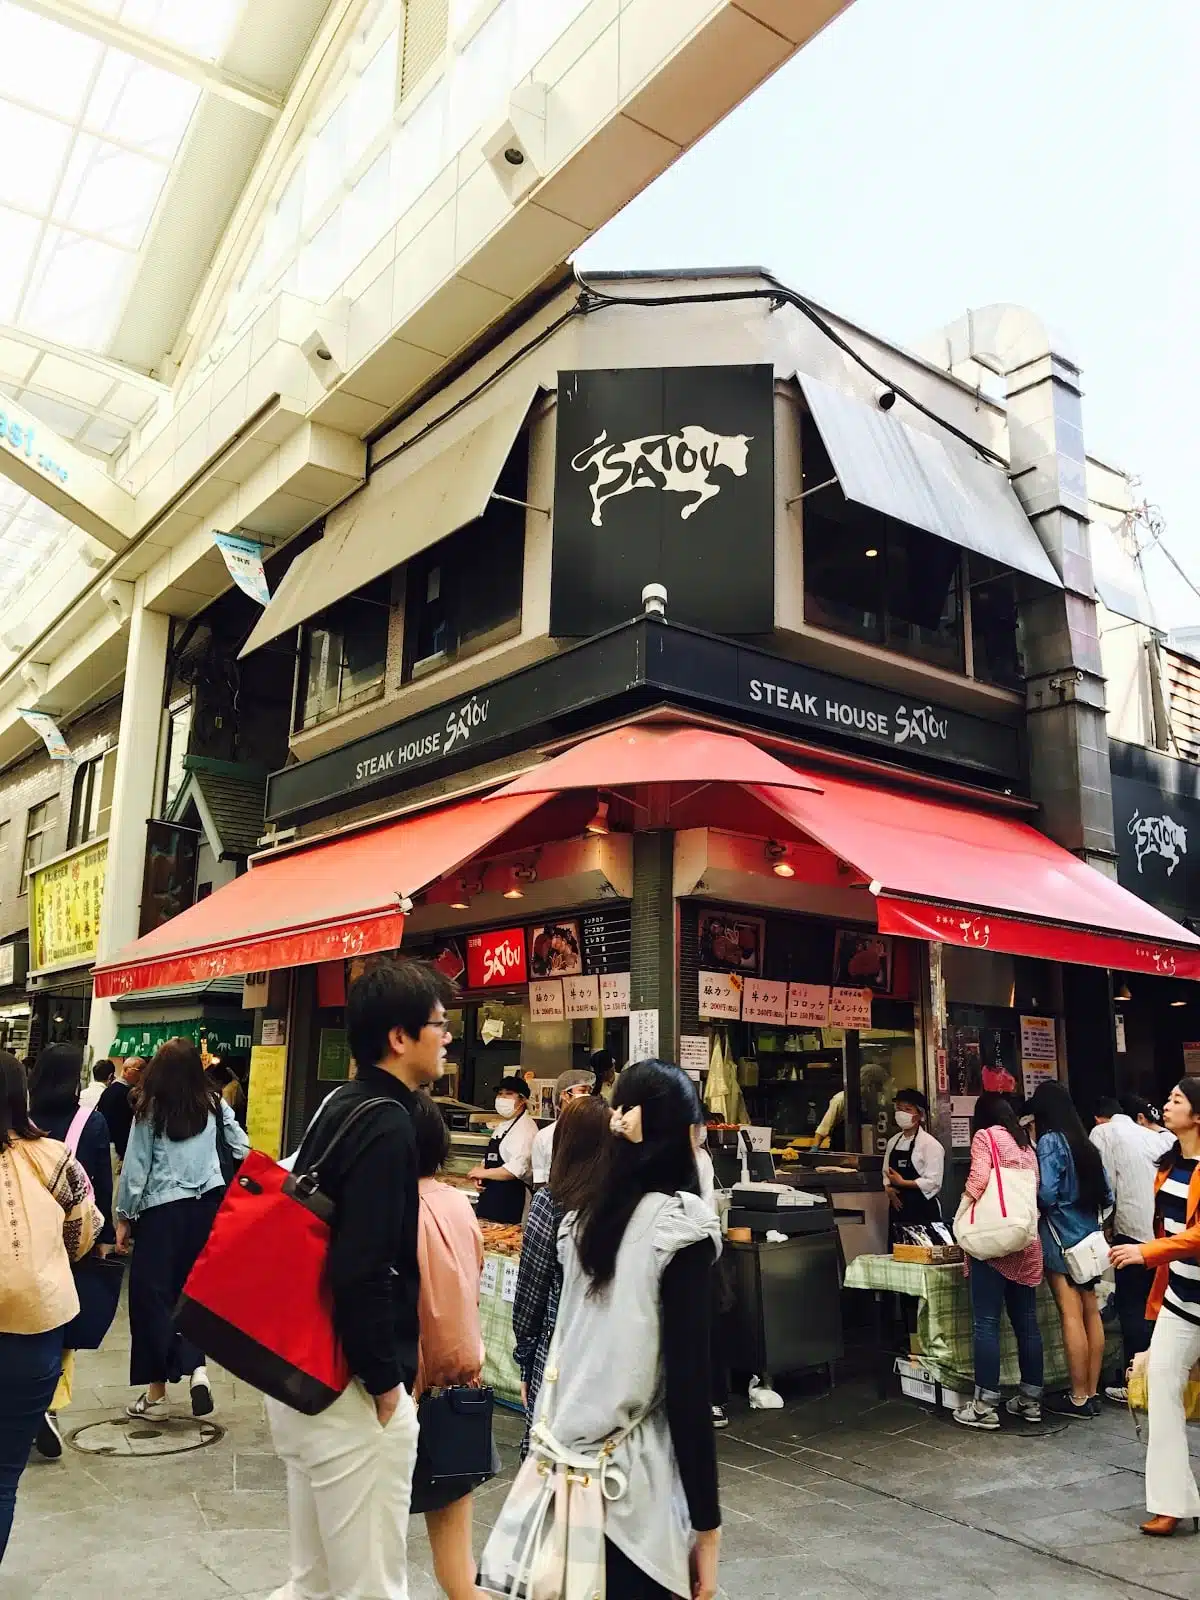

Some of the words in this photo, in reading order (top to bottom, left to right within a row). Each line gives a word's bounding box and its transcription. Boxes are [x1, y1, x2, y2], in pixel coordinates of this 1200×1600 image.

[593, 435, 722, 502] SATOU
[749, 679, 819, 717] STEAK
[825, 700, 889, 735] HOUSE
[894, 705, 949, 745] SATOU
[355, 750, 395, 780] STEAK
[398, 732, 441, 764] HOUSE
[443, 695, 490, 756] SATOU
[483, 939, 521, 984] SATOU
[570, 988, 592, 1000] 牛カツ
[605, 991, 626, 999] コロッ
[752, 991, 778, 1003] 牛カツ
[793, 1000, 825, 1010] コロッケ
